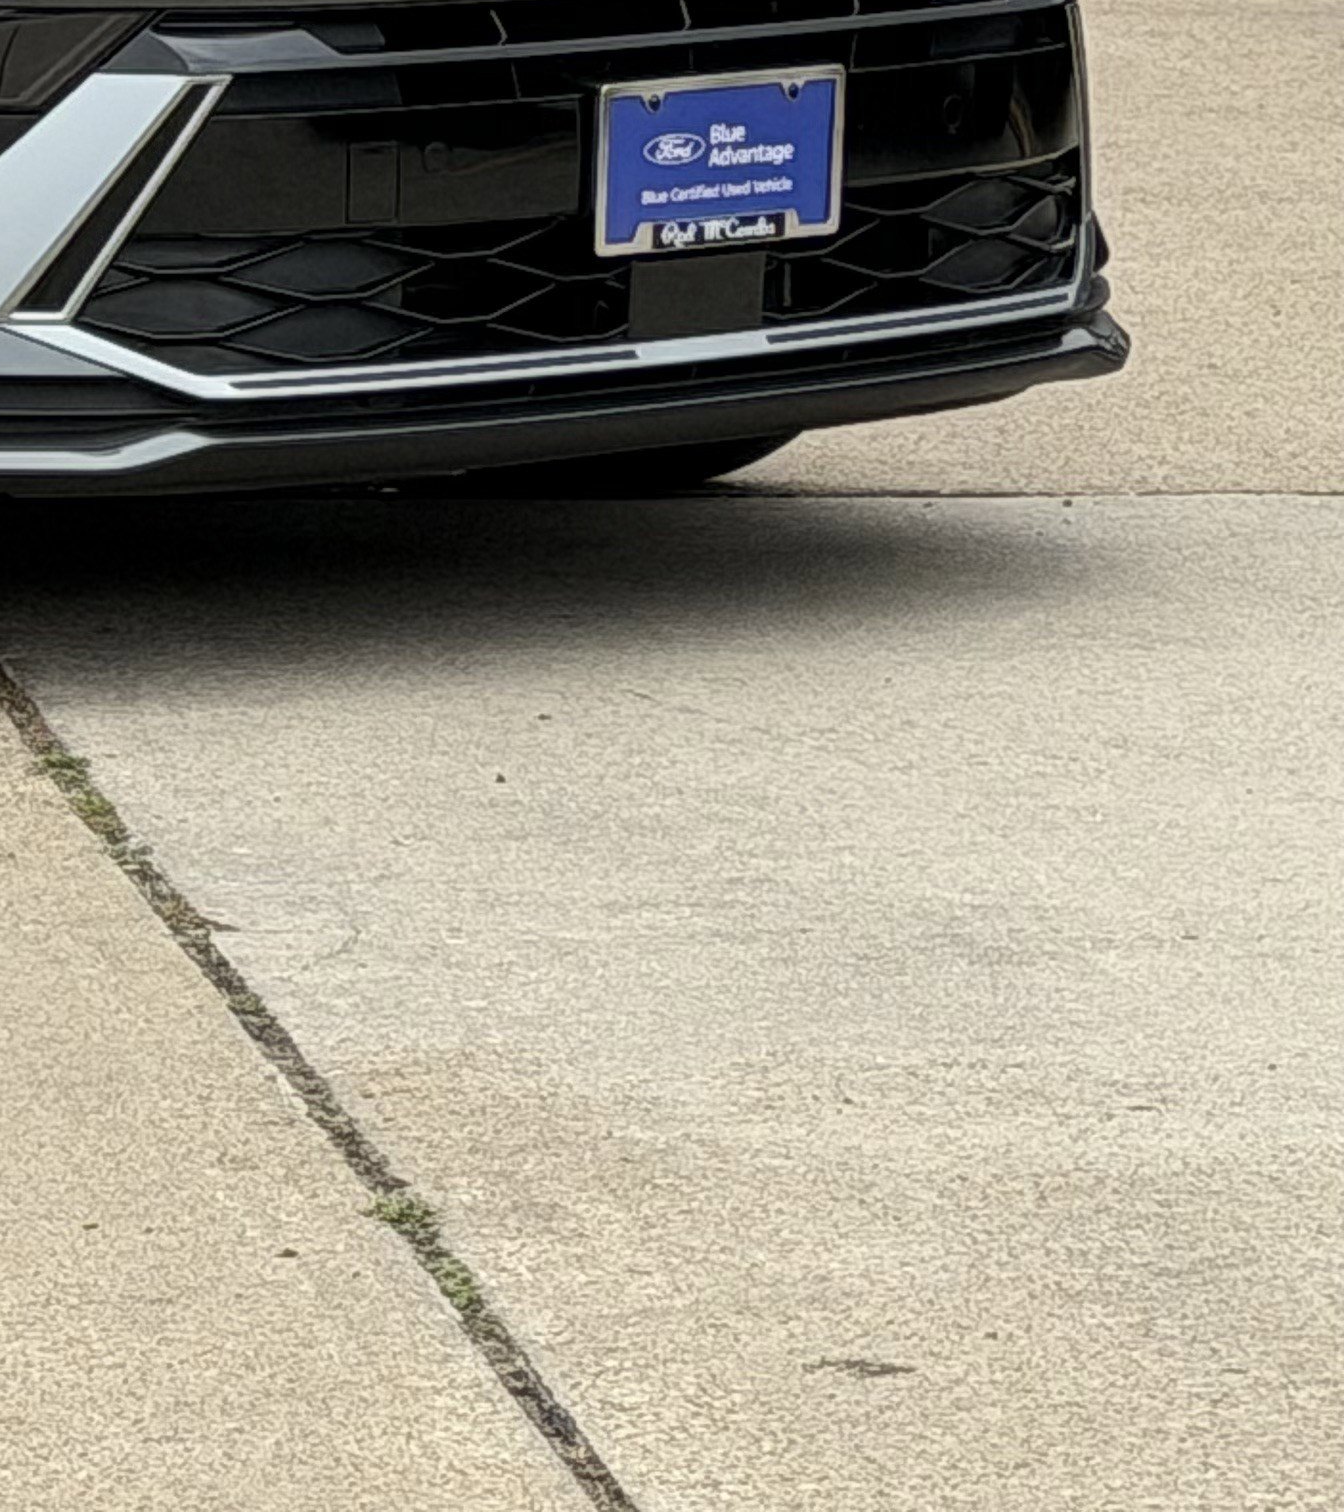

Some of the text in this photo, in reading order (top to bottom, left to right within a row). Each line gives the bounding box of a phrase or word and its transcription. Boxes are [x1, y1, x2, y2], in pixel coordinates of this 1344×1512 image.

[710, 123, 746, 145] Blue
[708, 143, 795, 167] Advantage
[640, 190, 669, 205] Blue
[721, 180, 751, 198] Used
[752, 176, 794, 194] Vehicle
